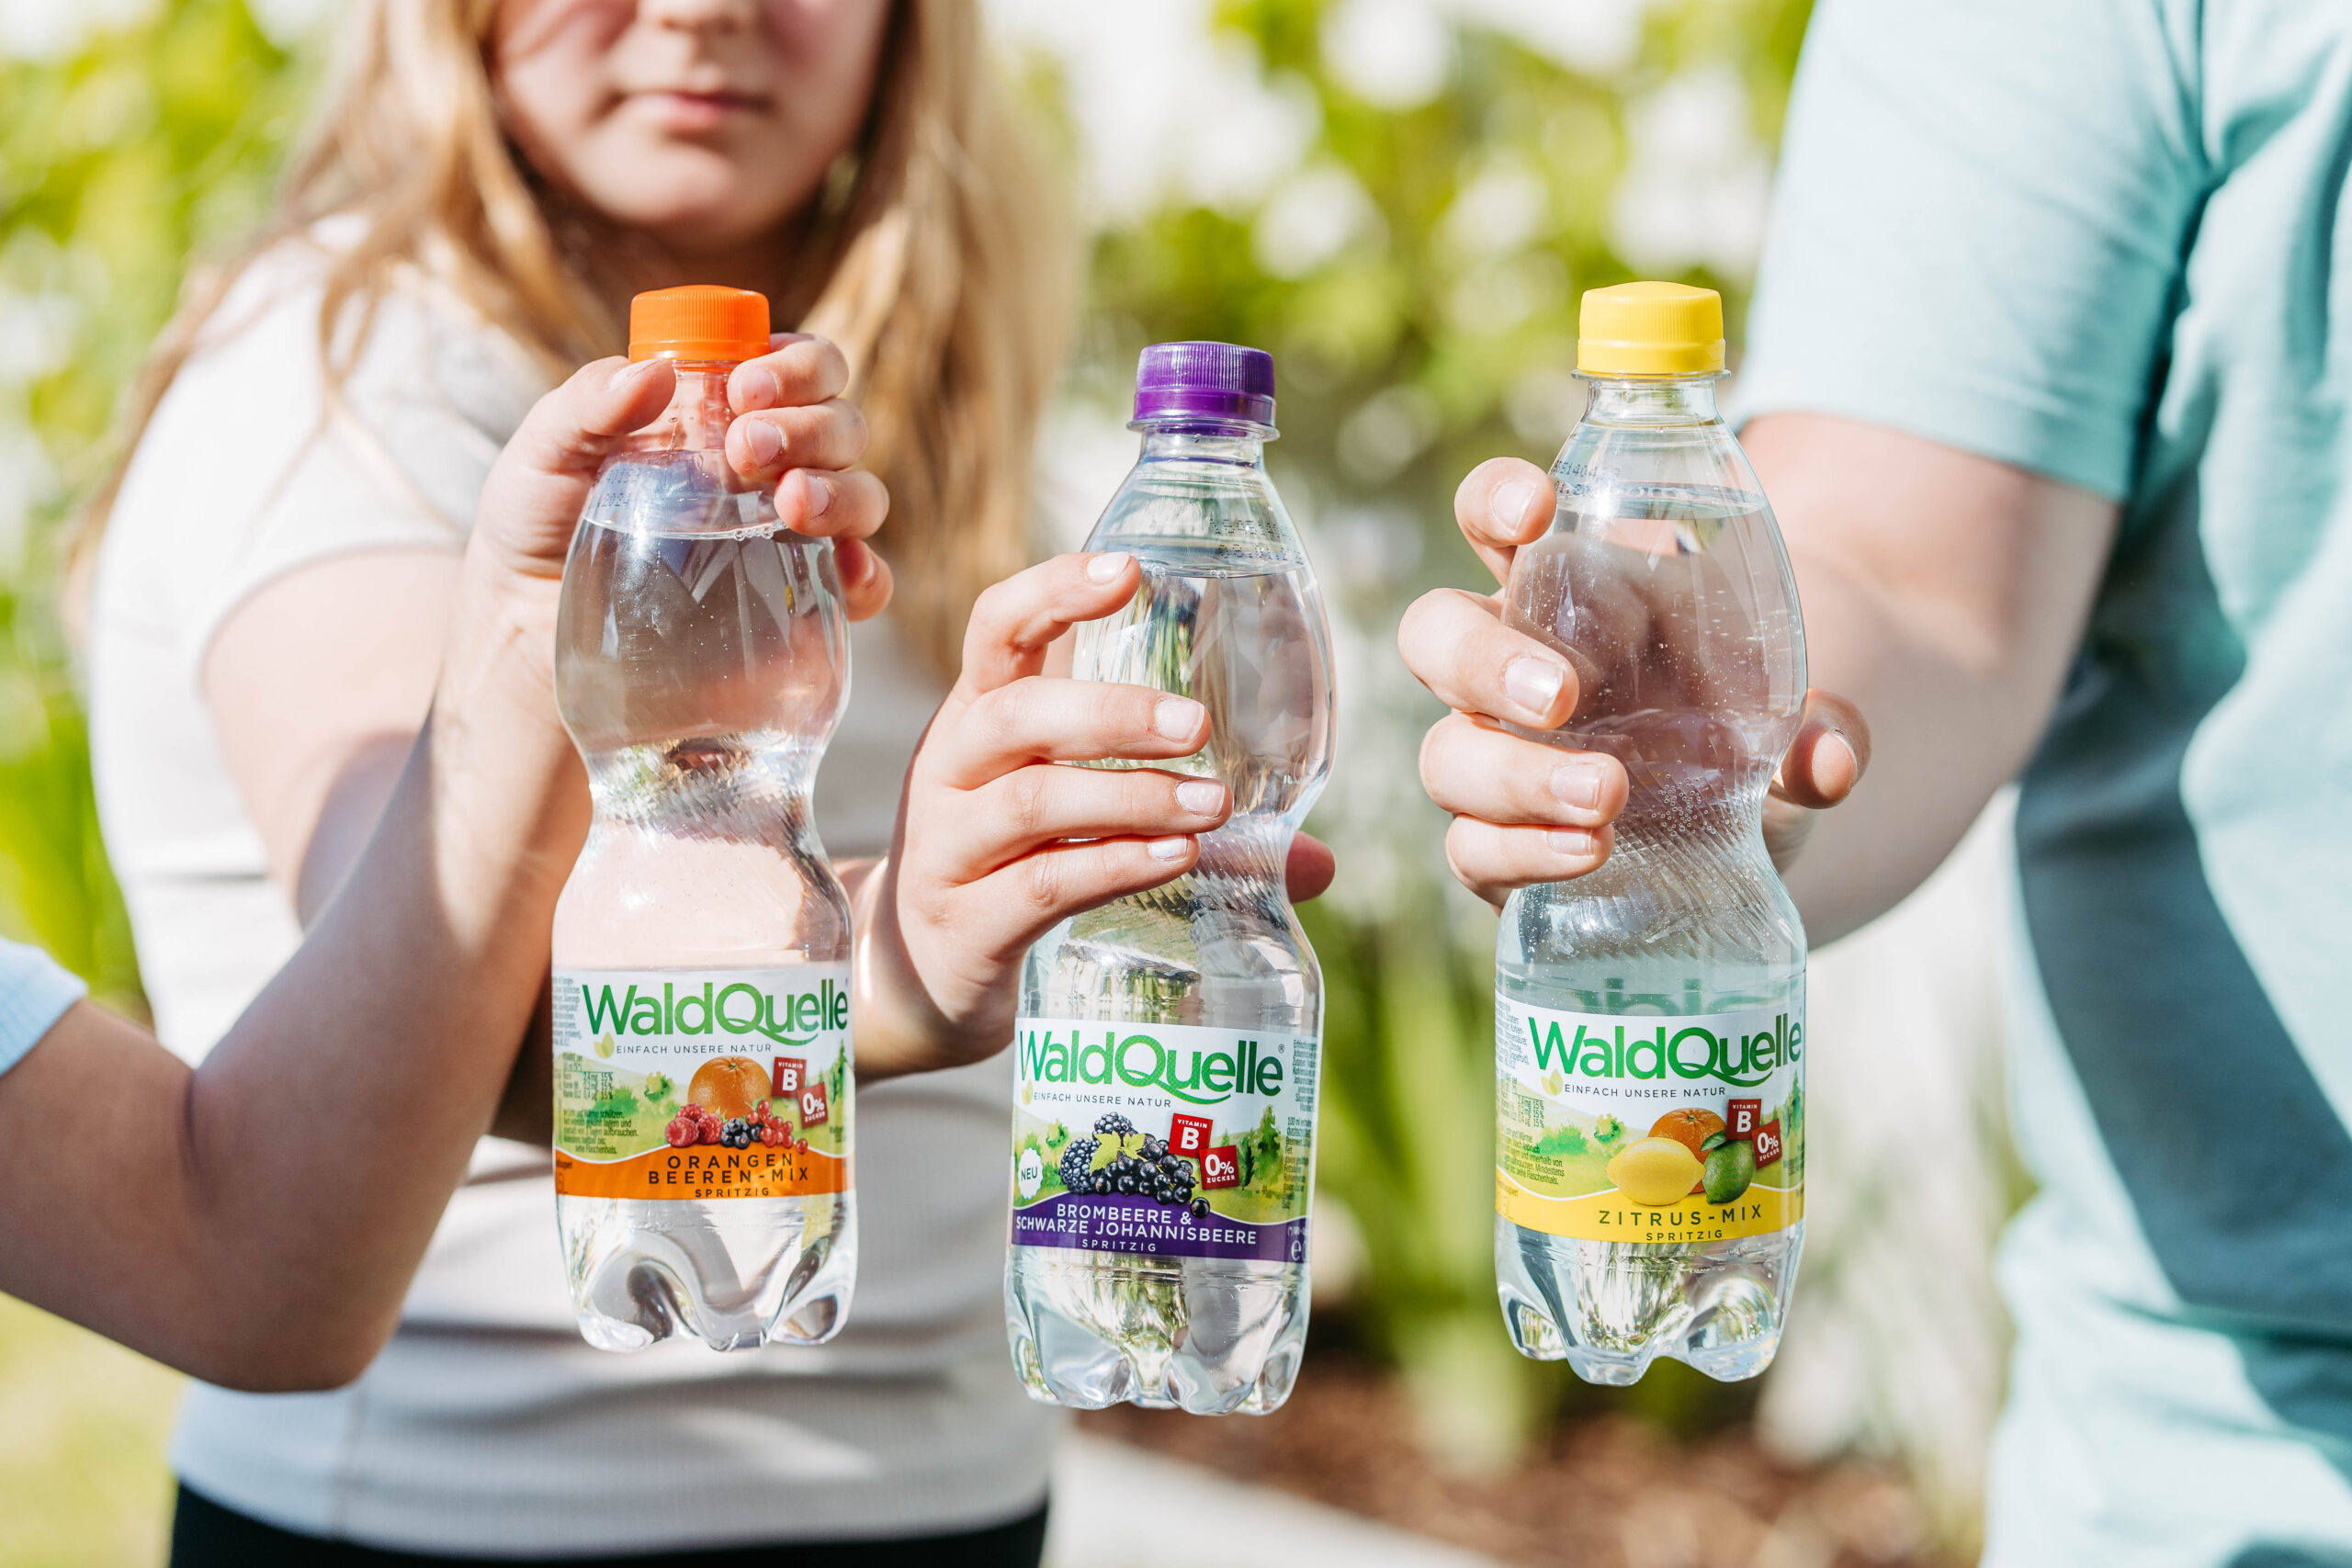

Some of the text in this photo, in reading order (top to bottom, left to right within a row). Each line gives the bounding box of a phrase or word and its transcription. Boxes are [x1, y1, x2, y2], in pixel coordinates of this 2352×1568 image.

[582, 978, 848, 1046] WaldQuelle
[616, 1043, 772, 1055] EINFACH UNSERE NATUR
[1528, 1012, 1802, 1088] WaldQuelle
[777, 1061, 803, 1069] VITAMIN
[1020, 1030, 1283, 1105] WaldQuelle
[782, 1068, 797, 1091] B
[1034, 1091, 1171, 1108] EINFACH UNSERE NATUR
[1565, 1084, 1725, 1099] EINFACH UNSERE NATUR
[802, 1092, 825, 1115] 0%
[1177, 1119, 1208, 1129] VITAMIN
[1736, 1111, 1752, 1133] B
[1181, 1126, 1200, 1150] B
[1757, 1132, 1779, 1154] 0%
[667, 1153, 793, 1169] ORANGEN
[1759, 1147, 1780, 1162] ZUCKER
[1021, 1167, 1038, 1180] NEU
[1204, 1154, 1235, 1178] 0%
[649, 1168, 808, 1185] BEEREN-MIX
[1206, 1175, 1236, 1184] ZUCKER
[695, 1188, 770, 1198] SPRITZIG
[1057, 1203, 1192, 1225] BROMBEERE &
[1599, 1203, 1762, 1226] ZITRUS-MIX
[1016, 1215, 1257, 1244] SCHWARZE JOHANNISBEERE
[1645, 1229, 1724, 1241] SPRITZIG
[1082, 1238, 1157, 1252] SPRITZIG
